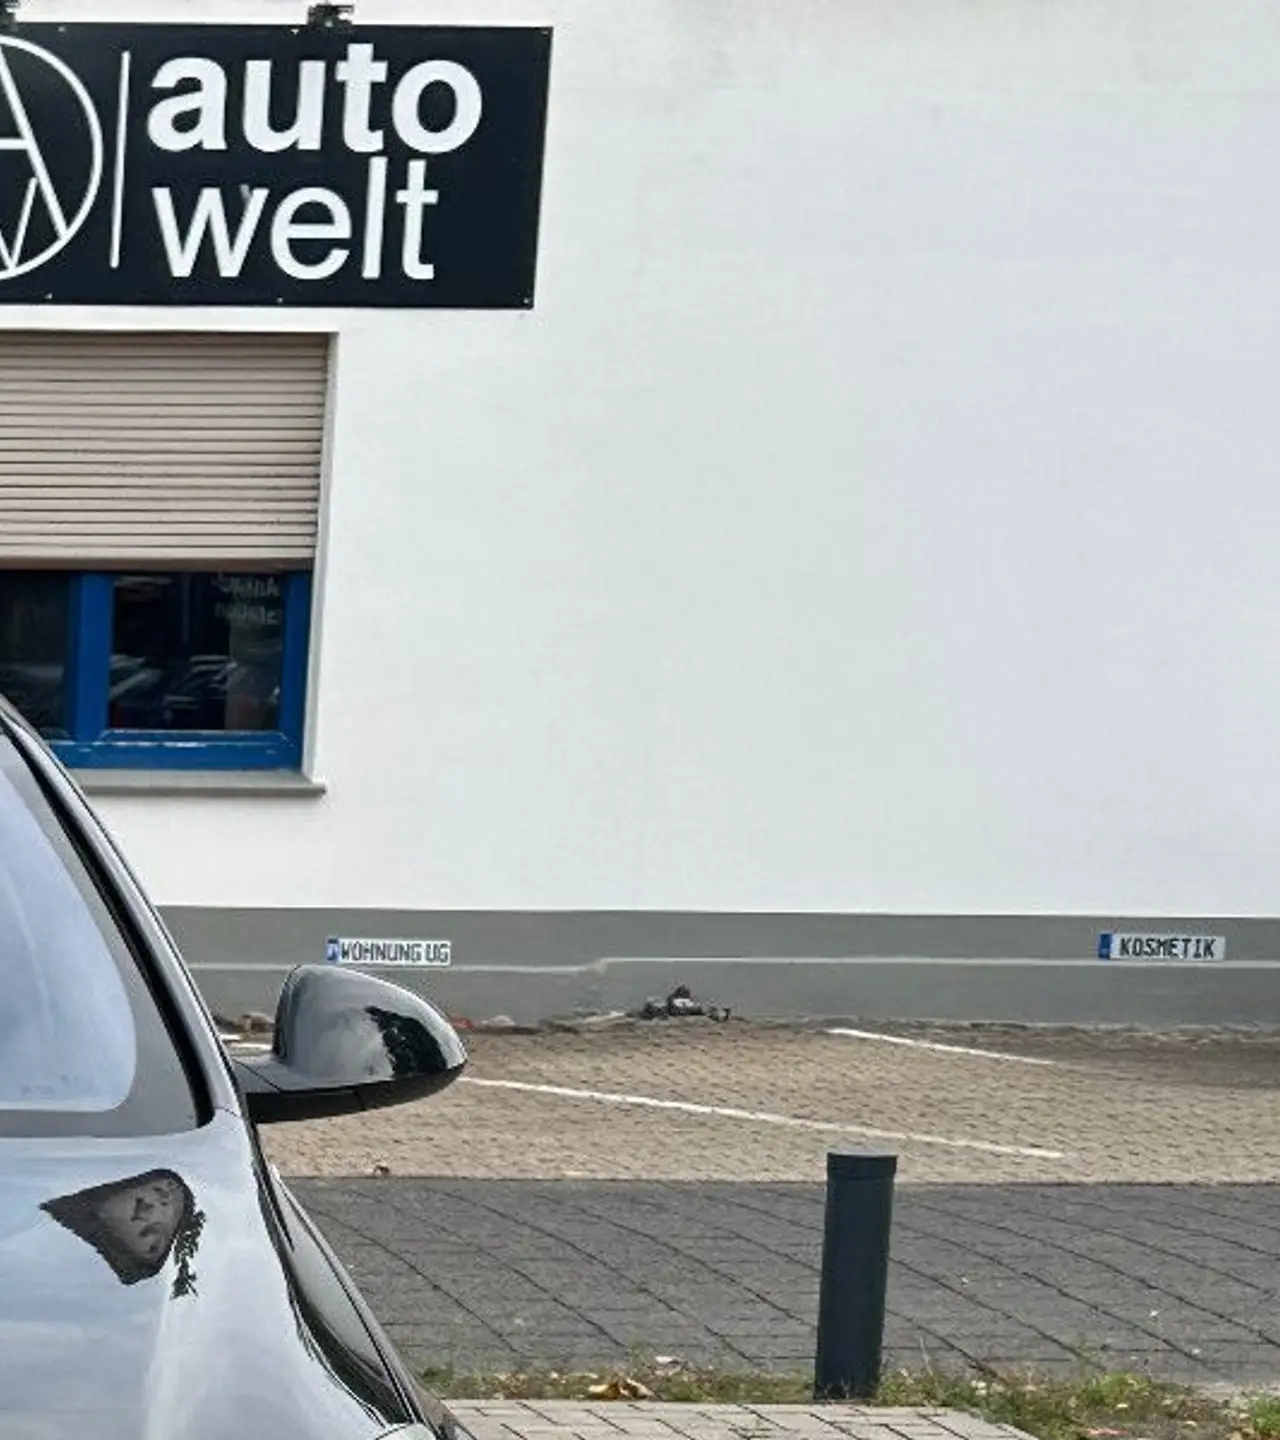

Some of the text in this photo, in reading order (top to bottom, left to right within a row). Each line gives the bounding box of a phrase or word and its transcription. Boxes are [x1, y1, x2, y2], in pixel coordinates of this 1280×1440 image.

[147, 42, 482, 154] auto
[151, 156, 439, 280] welt
[1120, 937, 1216, 959] KOSMETIK
